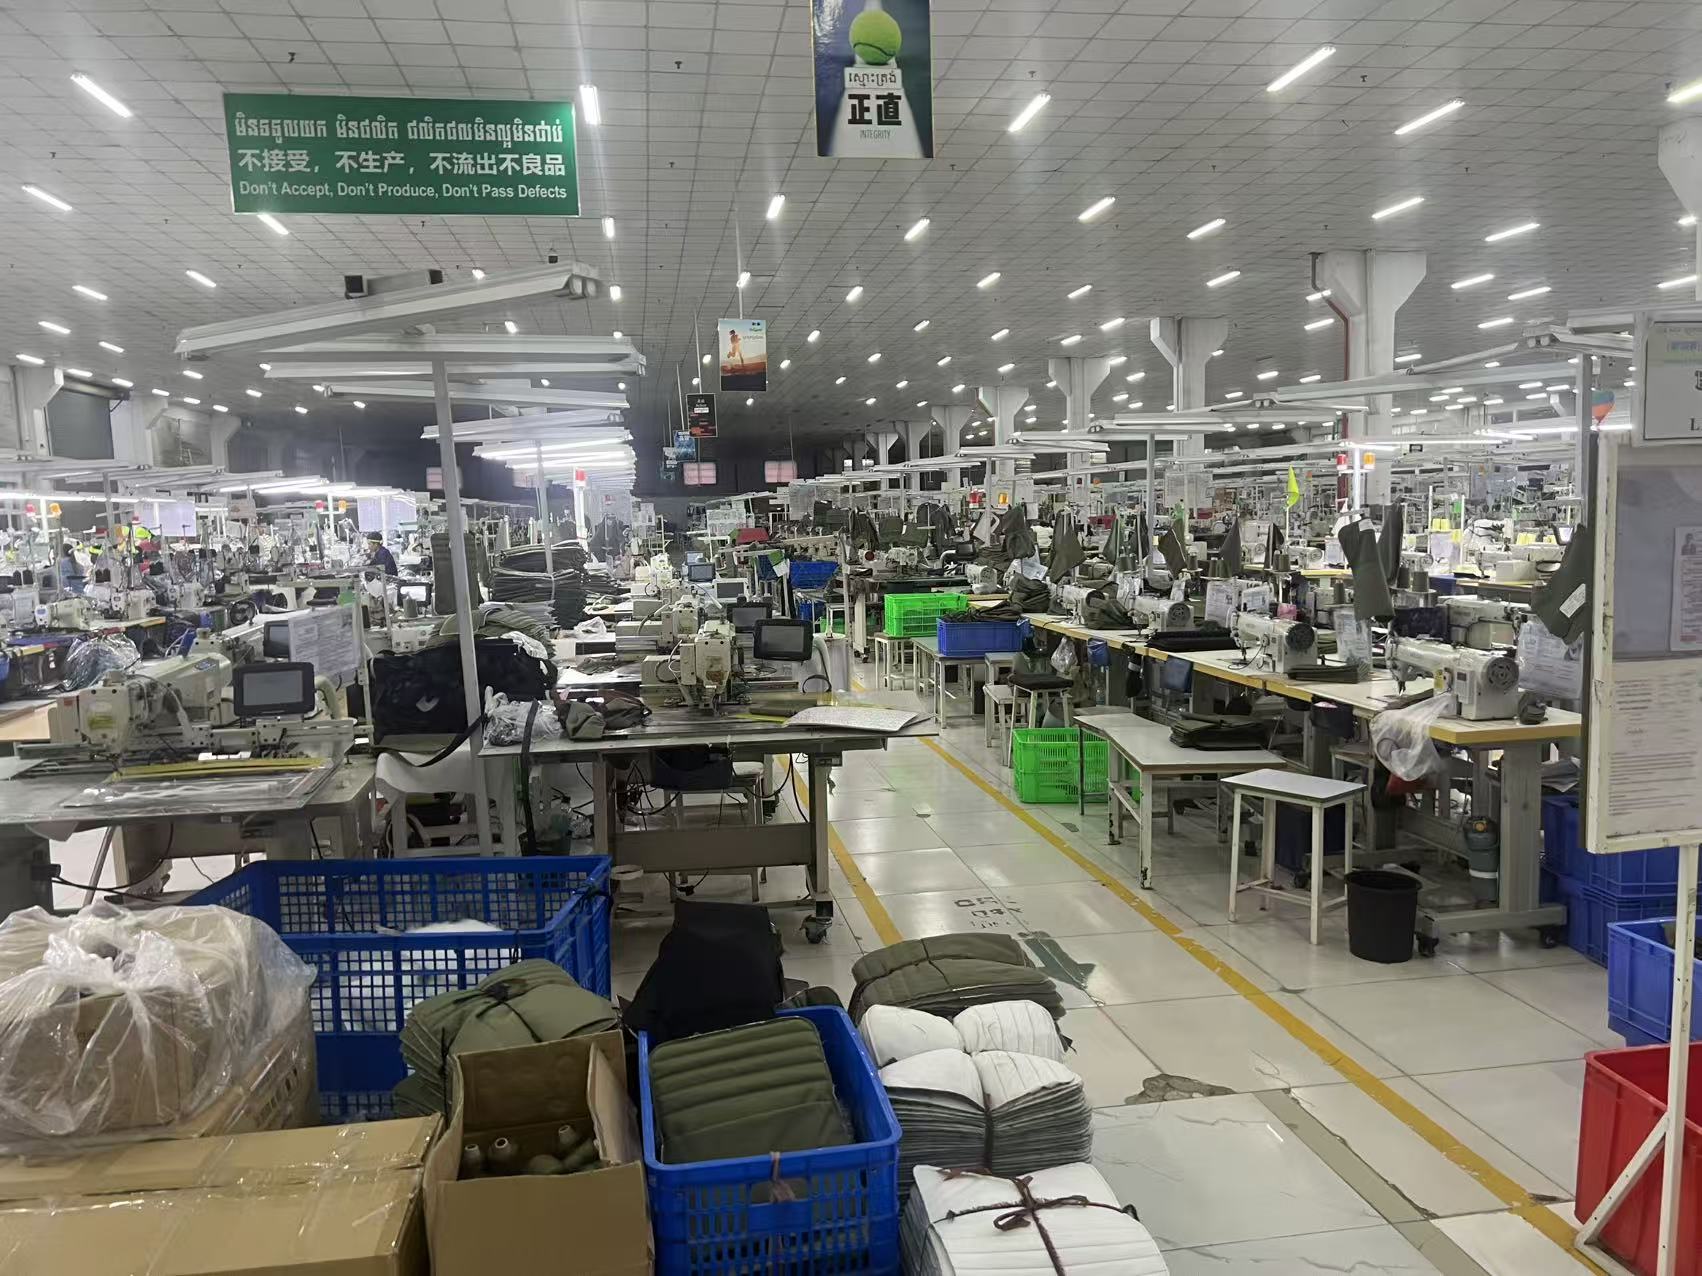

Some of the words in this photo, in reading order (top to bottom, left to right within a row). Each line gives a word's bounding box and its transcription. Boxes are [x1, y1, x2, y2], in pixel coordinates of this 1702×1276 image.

[847, 92, 902, 126] 正直
[860, 129, 891, 139] INTEGRITY
[239, 180, 277, 195] Don't
[281, 181, 334, 199] Accept,
[337, 182, 375, 196] Don't
[378, 183, 439, 199] Produce,
[442, 183, 478, 197] Don't
[482, 184, 514, 198] Pass
[518, 184, 567, 198] Defects
